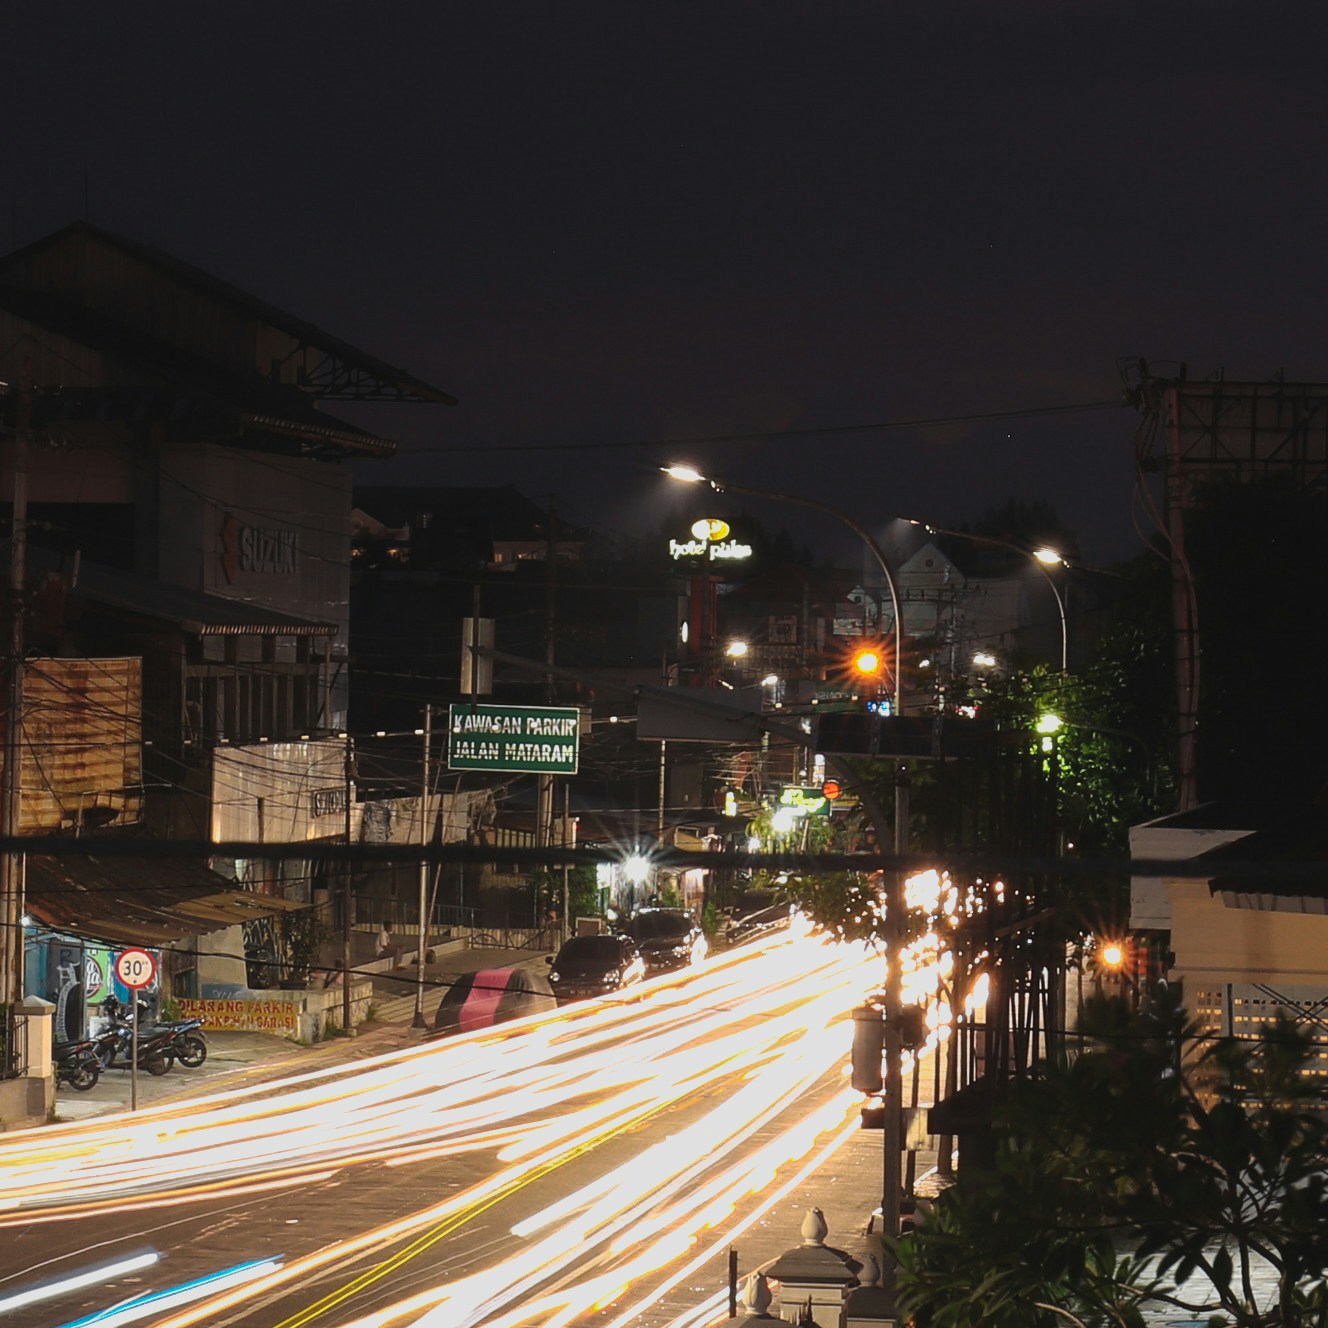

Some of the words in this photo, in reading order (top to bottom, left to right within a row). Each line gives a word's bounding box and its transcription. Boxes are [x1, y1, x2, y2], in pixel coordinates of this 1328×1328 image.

[241, 527, 299, 574] SUZUKI
[669, 539, 707, 561] hotel
[454, 714, 521, 735] KAWASAN
[526, 717, 574, 737] PARKIR
[454, 741, 499, 760] JALAN
[505, 743, 574, 763] MATARAM
[123, 960, 142, 976] 30
[178, 1000, 243, 1012] DILARANG
[247, 1001, 294, 1014] PARKIR
[256, 1016, 294, 1029] GARASI
